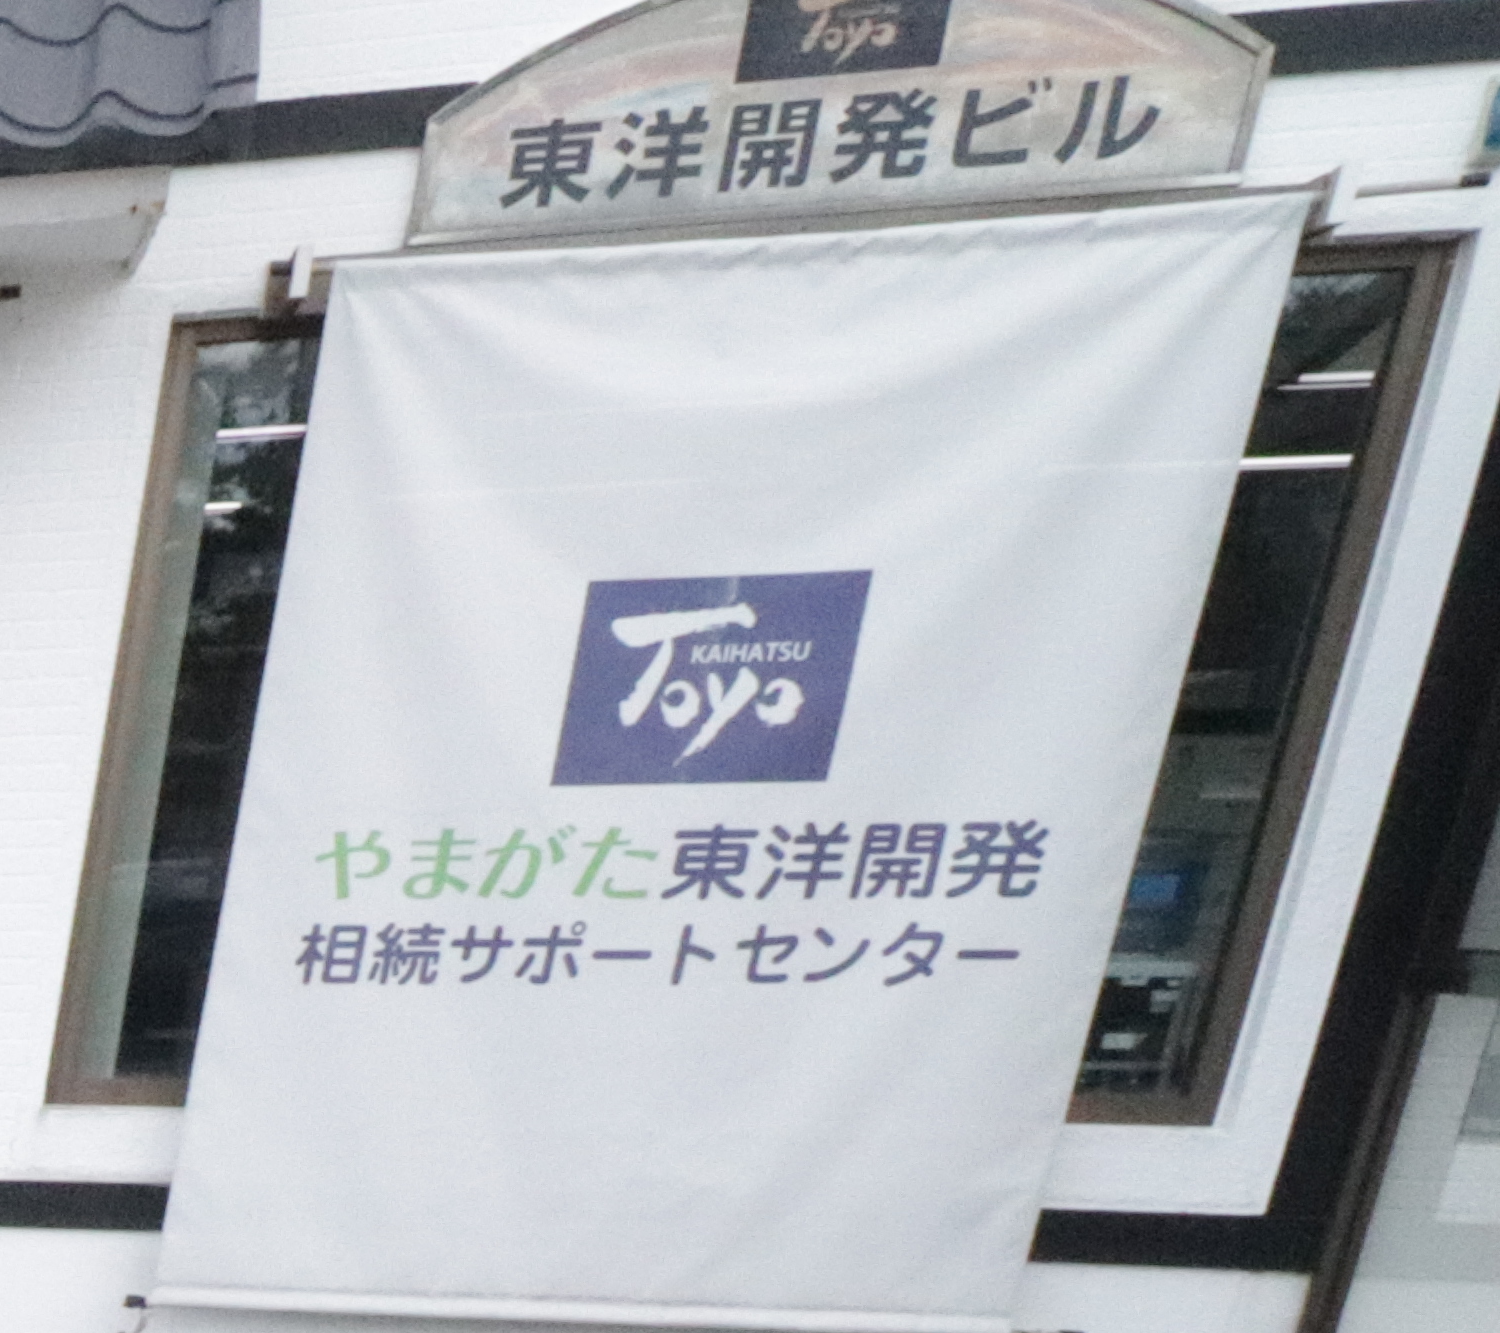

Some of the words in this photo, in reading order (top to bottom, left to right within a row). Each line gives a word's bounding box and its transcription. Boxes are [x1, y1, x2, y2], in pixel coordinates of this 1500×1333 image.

[499, 75, 1162, 209] 東洋開発ビル
[611, 602, 805, 767] Toyo
[691, 640, 812, 664] KAIHATSU
[314, 819, 1050, 900] やまがた東洋開発
[296, 920, 1020, 986] 相続サポートセンター
